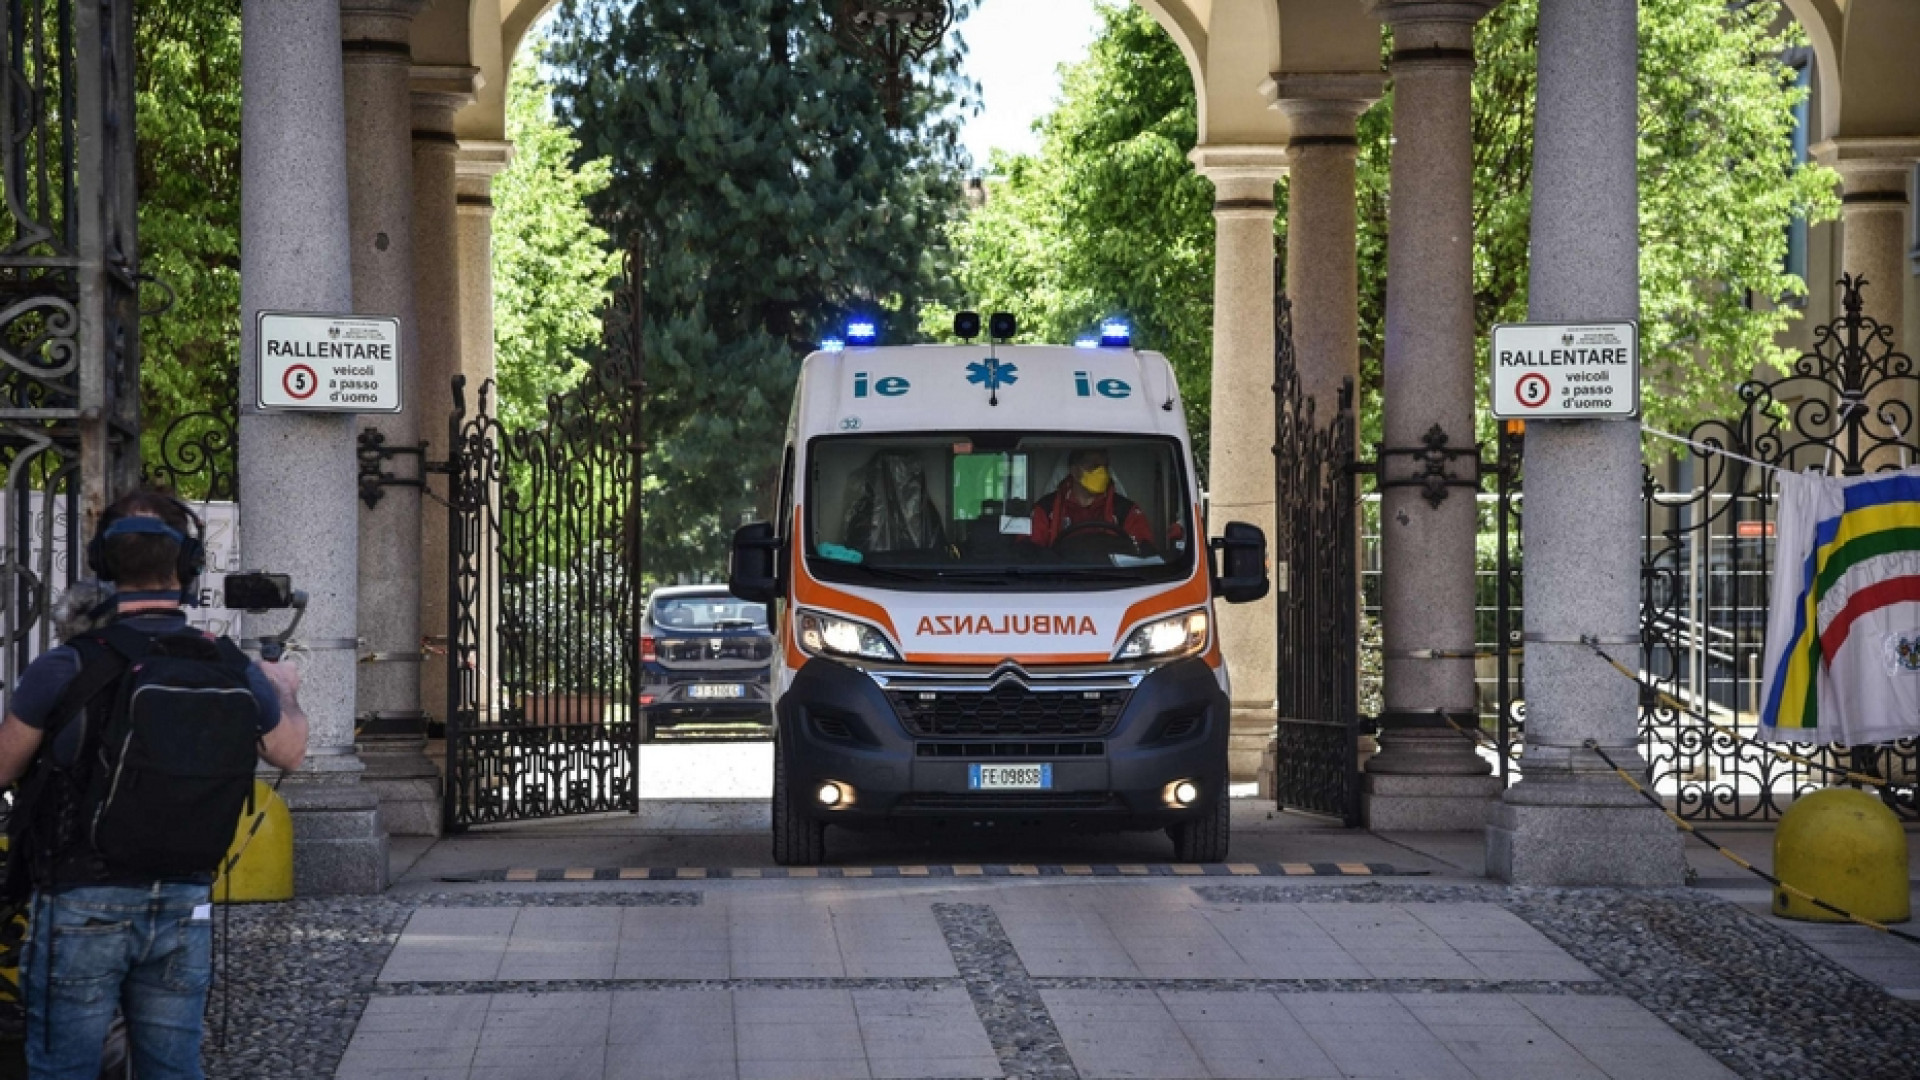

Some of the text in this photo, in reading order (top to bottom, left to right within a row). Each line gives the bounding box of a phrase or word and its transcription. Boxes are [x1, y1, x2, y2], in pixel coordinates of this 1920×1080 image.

[267, 339, 392, 360] RALLENTARE
[1499, 347, 1628, 367] RALLENTARE
[333, 364, 374, 376] veicoli
[1565, 370, 1609, 382] veicoli
[295, 373, 306, 390] 5
[329, 379, 378, 391] a passo
[1527, 382, 1538, 398] 5
[1561, 385, 1613, 397] a passo
[329, 391, 378, 403] d'uomo
[1562, 397, 1612, 409] d'uomo
